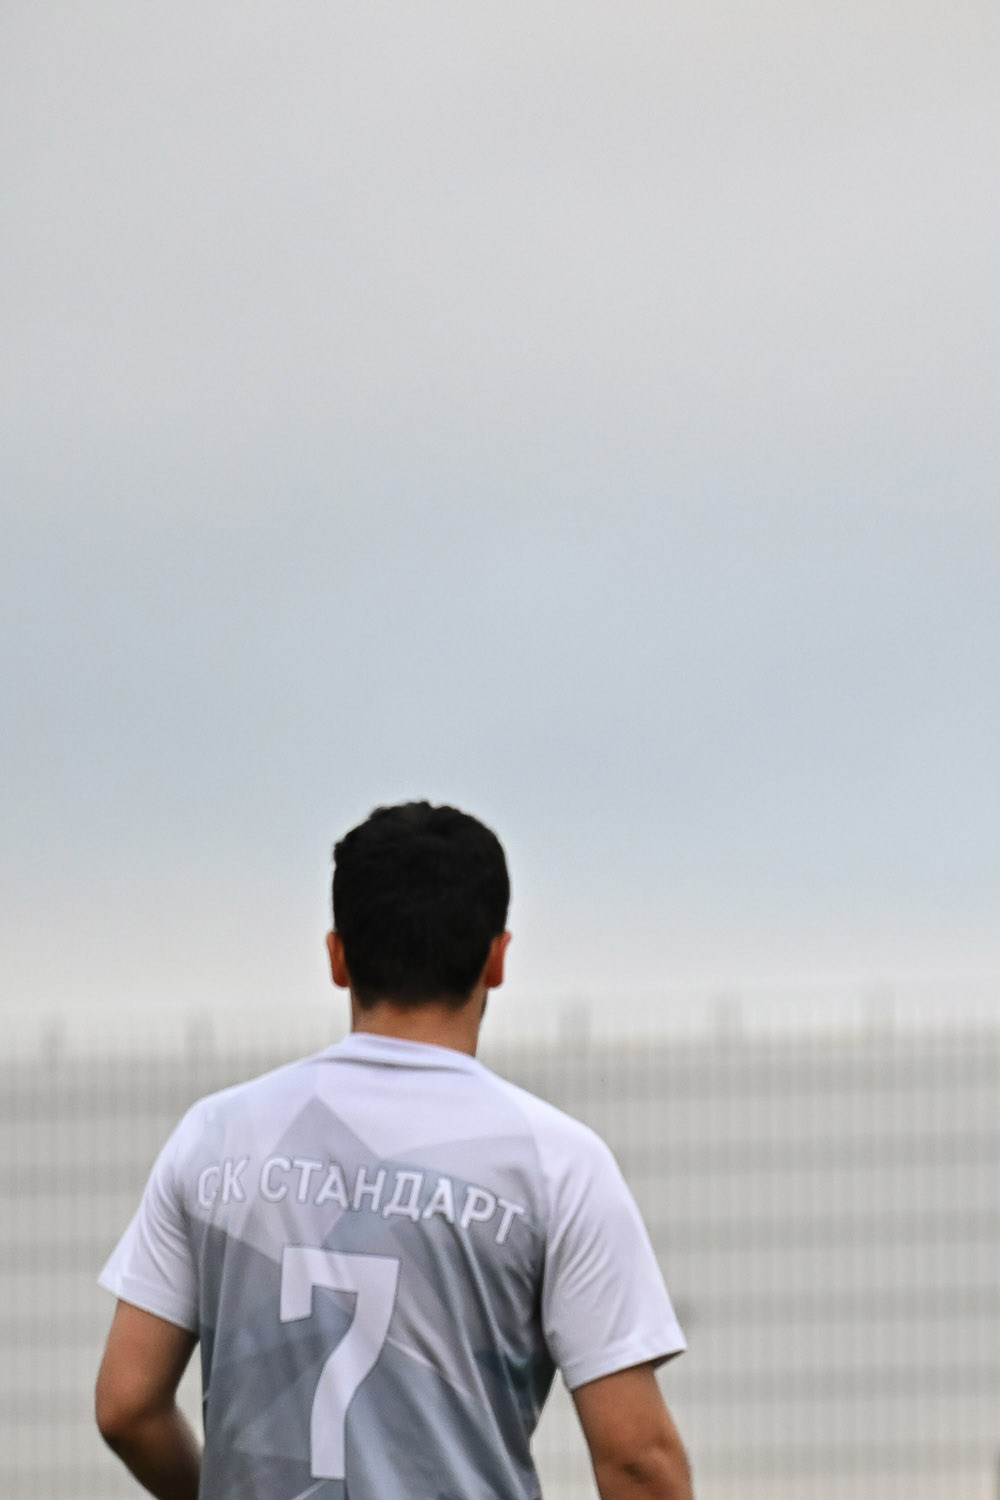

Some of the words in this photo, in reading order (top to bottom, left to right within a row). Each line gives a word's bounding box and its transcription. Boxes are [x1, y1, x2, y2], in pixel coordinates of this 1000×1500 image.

[199, 1158, 249, 1210] СК
[258, 1157, 525, 1244] СТАНДАРТ
[279, 1245, 400, 1480] 7
